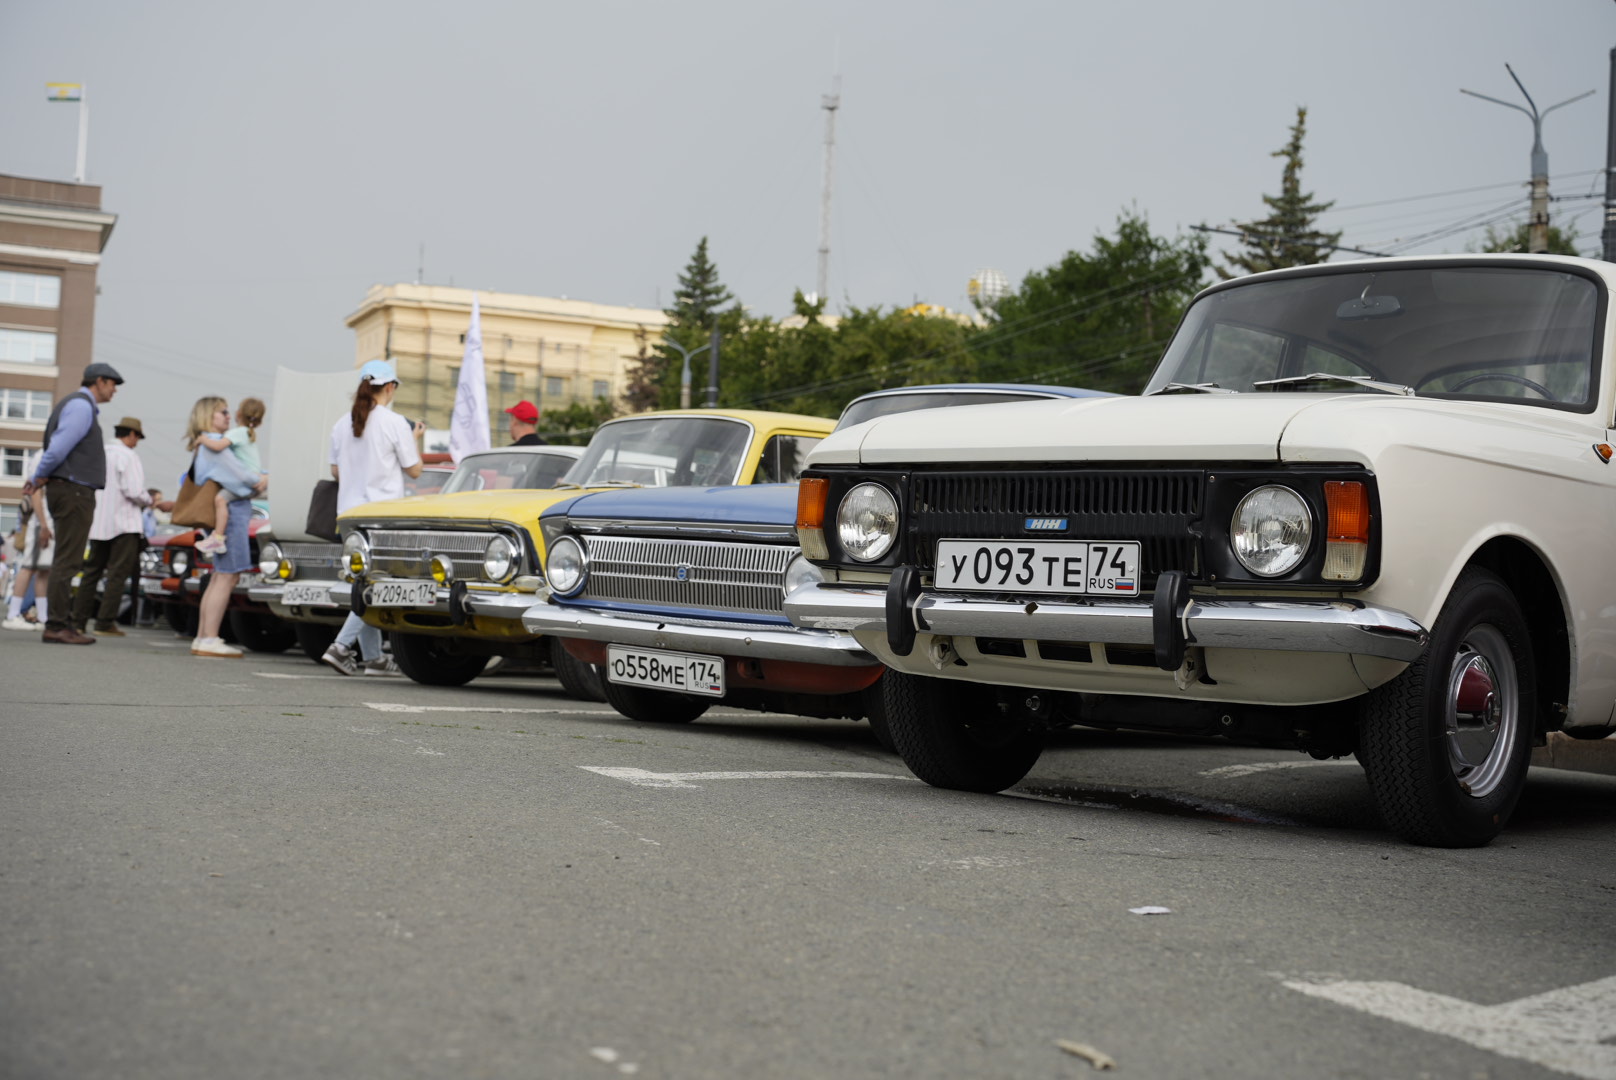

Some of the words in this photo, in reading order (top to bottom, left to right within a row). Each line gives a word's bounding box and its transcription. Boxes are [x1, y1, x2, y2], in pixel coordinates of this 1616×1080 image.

[951, 546, 1082, 587] У093ТЕ
[1092, 546, 1126, 577] 74
[417, 584, 435, 599] 174
[1089, 578, 1114, 589] RUS
[615, 654, 685, 685] О558МЕ
[688, 661, 717, 682] 174
